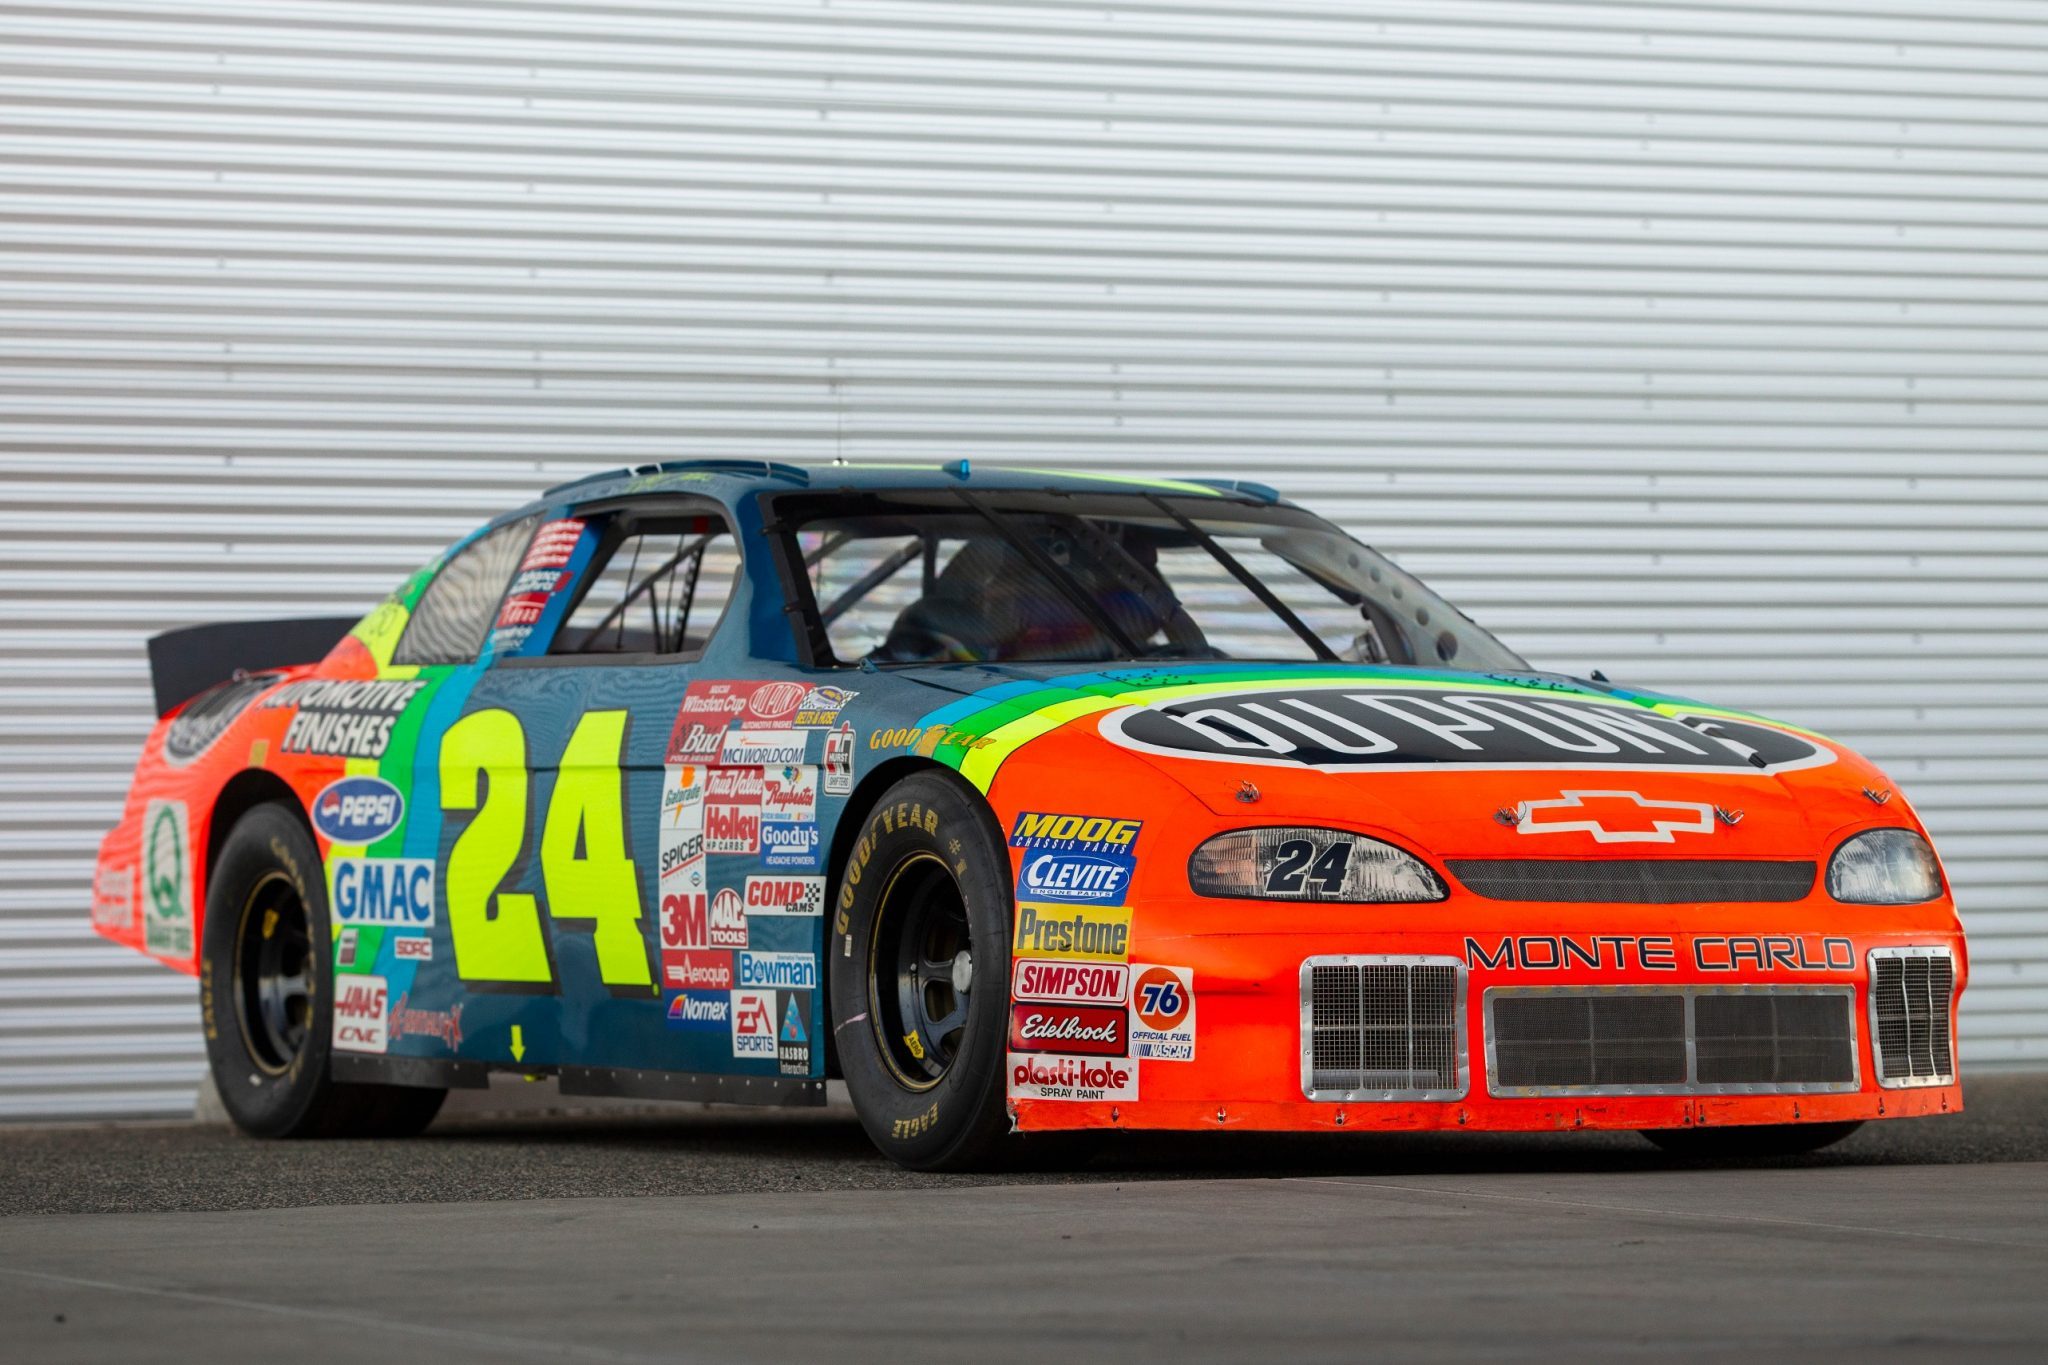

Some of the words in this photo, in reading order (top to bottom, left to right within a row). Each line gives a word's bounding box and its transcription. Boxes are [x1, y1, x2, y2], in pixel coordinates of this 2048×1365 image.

[681, 695, 724, 713] Winston
[723, 694, 747, 716] Cup
[283, 711, 396, 757] FINISHES
[680, 724, 728, 754] Bud
[829, 752, 849, 763] HURST
[726, 768, 763, 799] Value
[338, 794, 393, 828] PEPSI
[705, 807, 760, 852] Holley
[762, 825, 819, 850] Goody's
[1014, 814, 1141, 844] MOOG
[438, 707, 656, 992] 24
[661, 833, 704, 873] SPICER
[718, 840, 745, 851] CARBS
[1015, 836, 1075, 851] CHASSIS
[1083, 841, 1128, 855] PARTS
[1027, 854, 1125, 890] CLEVITE
[1264, 838, 1354, 896] 24
[334, 861, 433, 923] GMAC
[747, 881, 805, 906] COMP
[1031, 888, 1073, 896] ENGINE
[1076, 890, 1112, 898] PARTS
[661, 894, 707, 946] 3M
[785, 902, 815, 914] CAMS
[711, 929, 747, 945] TOOLS
[1017, 908, 1129, 955] Prestone
[1463, 935, 1678, 972] MONTE
[1692, 936, 1857, 972] CARLO
[679, 951, 730, 988] Aeroquip
[741, 953, 815, 986] Bowman
[1021, 965, 1121, 997] SIMPSON
[683, 997, 729, 1021] Nomex
[1140, 981, 1182, 1017] 76
[736, 1035, 774, 1052] SPORTS
[1020, 1014, 1117, 1044] Edelbrock
[1131, 1031, 1168, 1040] OFFICIAL
[1170, 1033, 1192, 1042] FUEL
[779, 1046, 809, 1060] HASBRO
[1150, 1044, 1192, 1059] NASCAR
[1014, 1056, 1129, 1089] plasti-kote
[1040, 1087, 1072, 1098] SPRAY
[1076, 1089, 1105, 1100] PAINT
